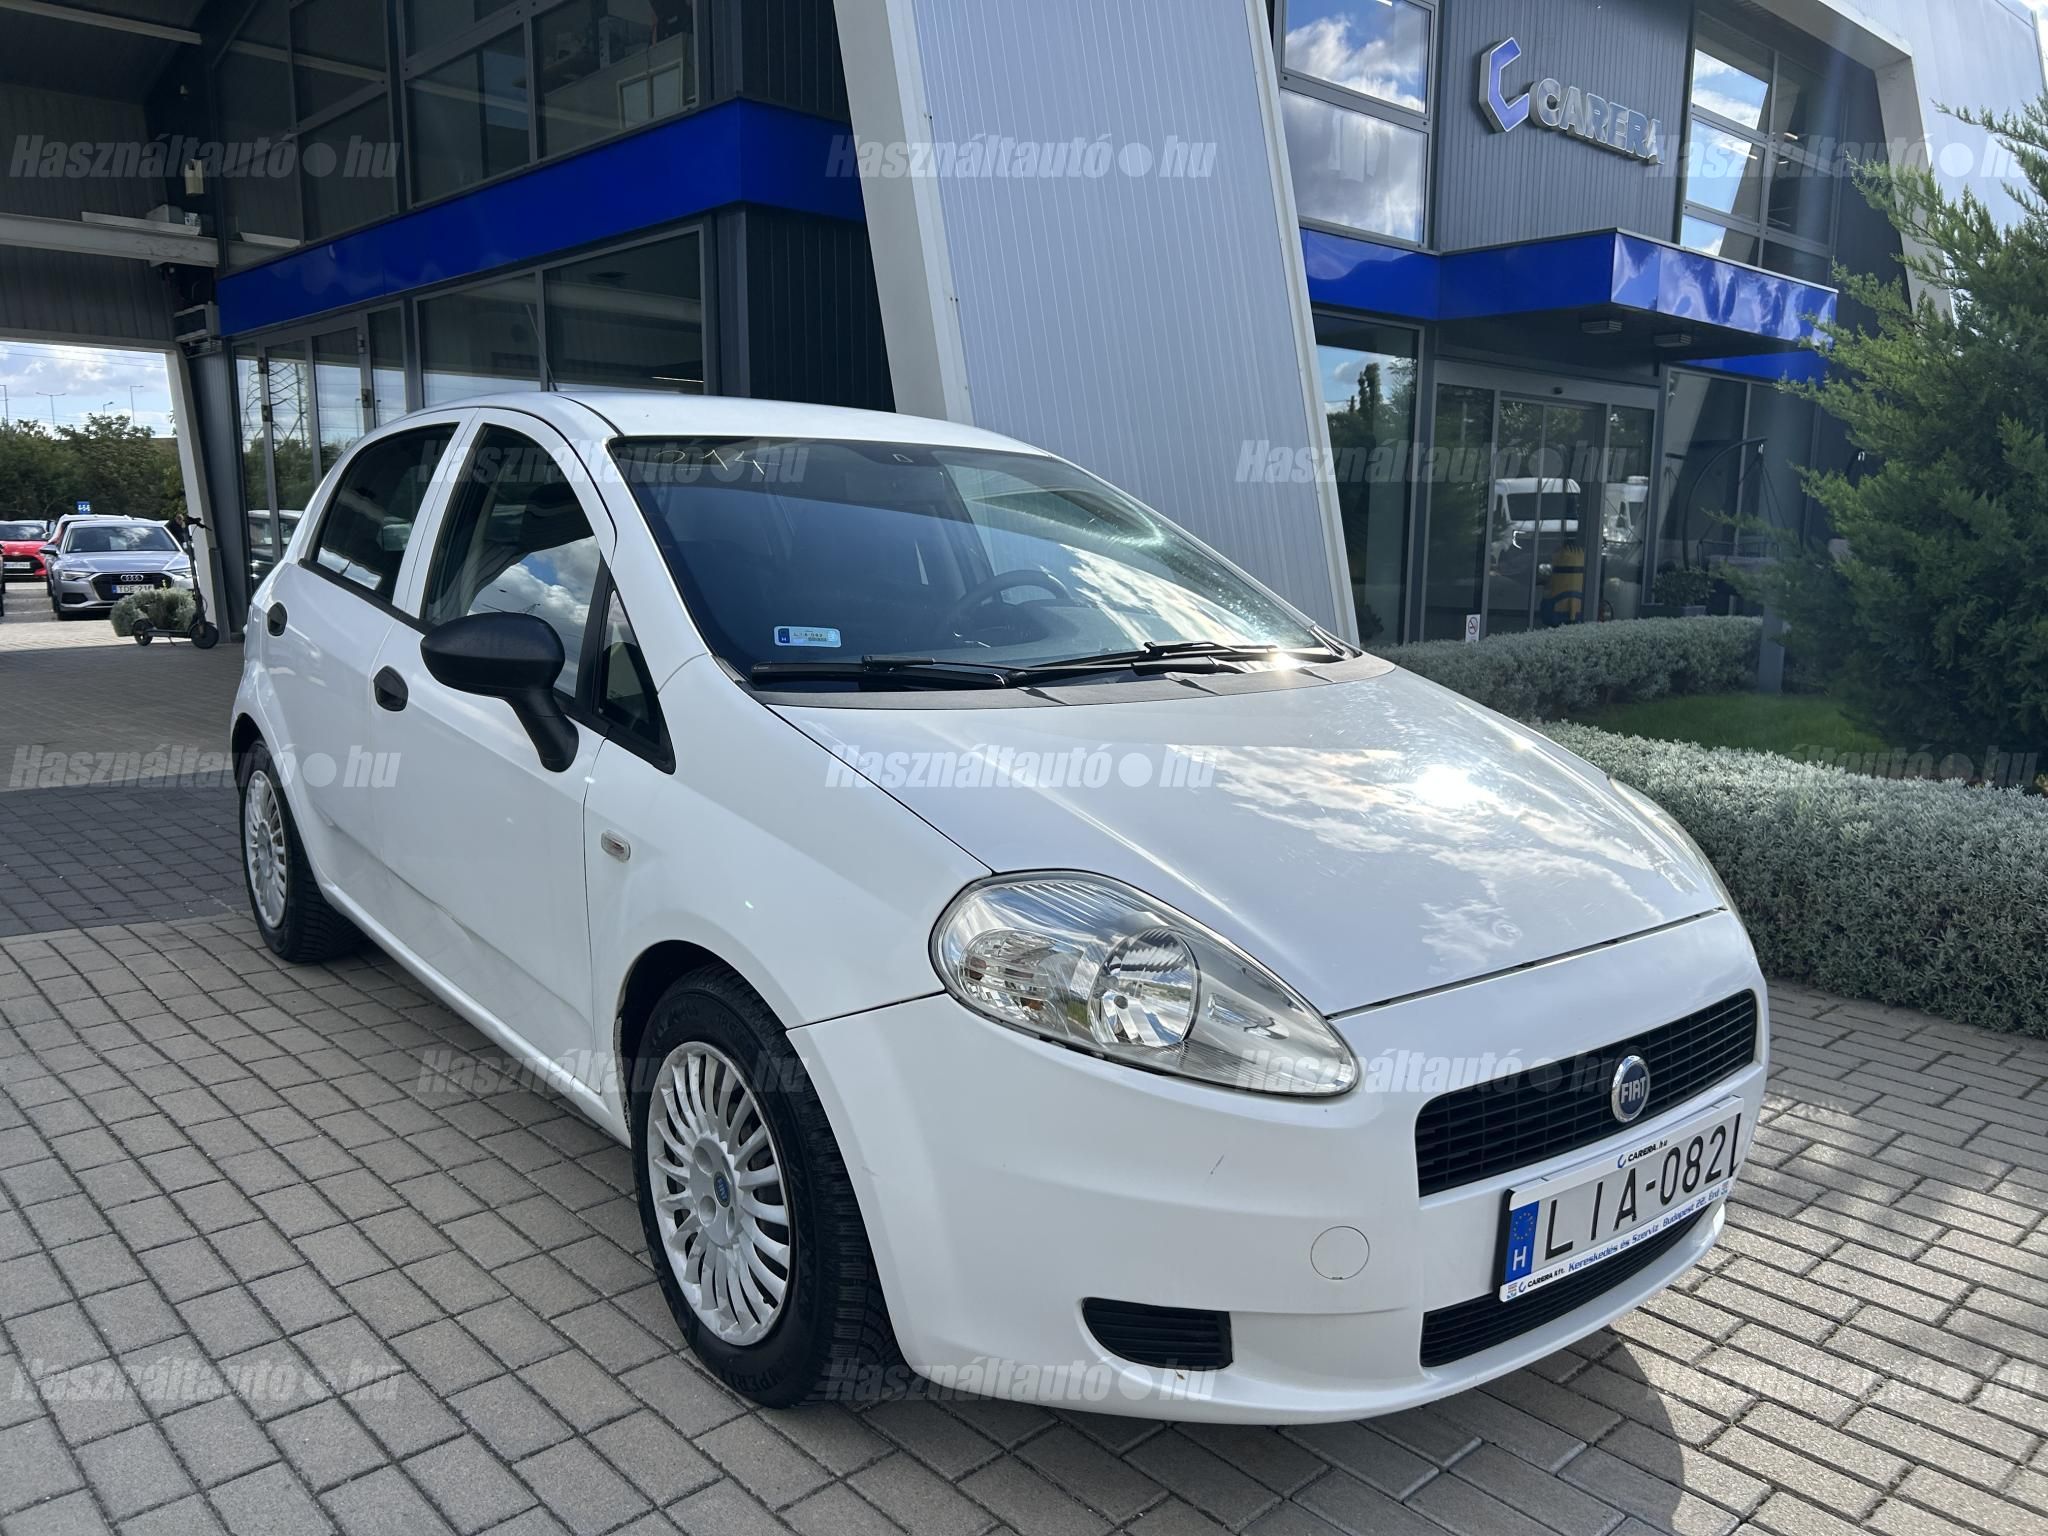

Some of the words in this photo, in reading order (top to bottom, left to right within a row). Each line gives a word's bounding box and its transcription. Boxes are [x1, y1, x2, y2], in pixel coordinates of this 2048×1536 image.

[1531, 78, 1665, 164] CARERA
[1621, 1076, 1646, 1104] FIAT
[1512, 1246, 1527, 1271] H
[1527, 1272, 1553, 1288] CARERA
